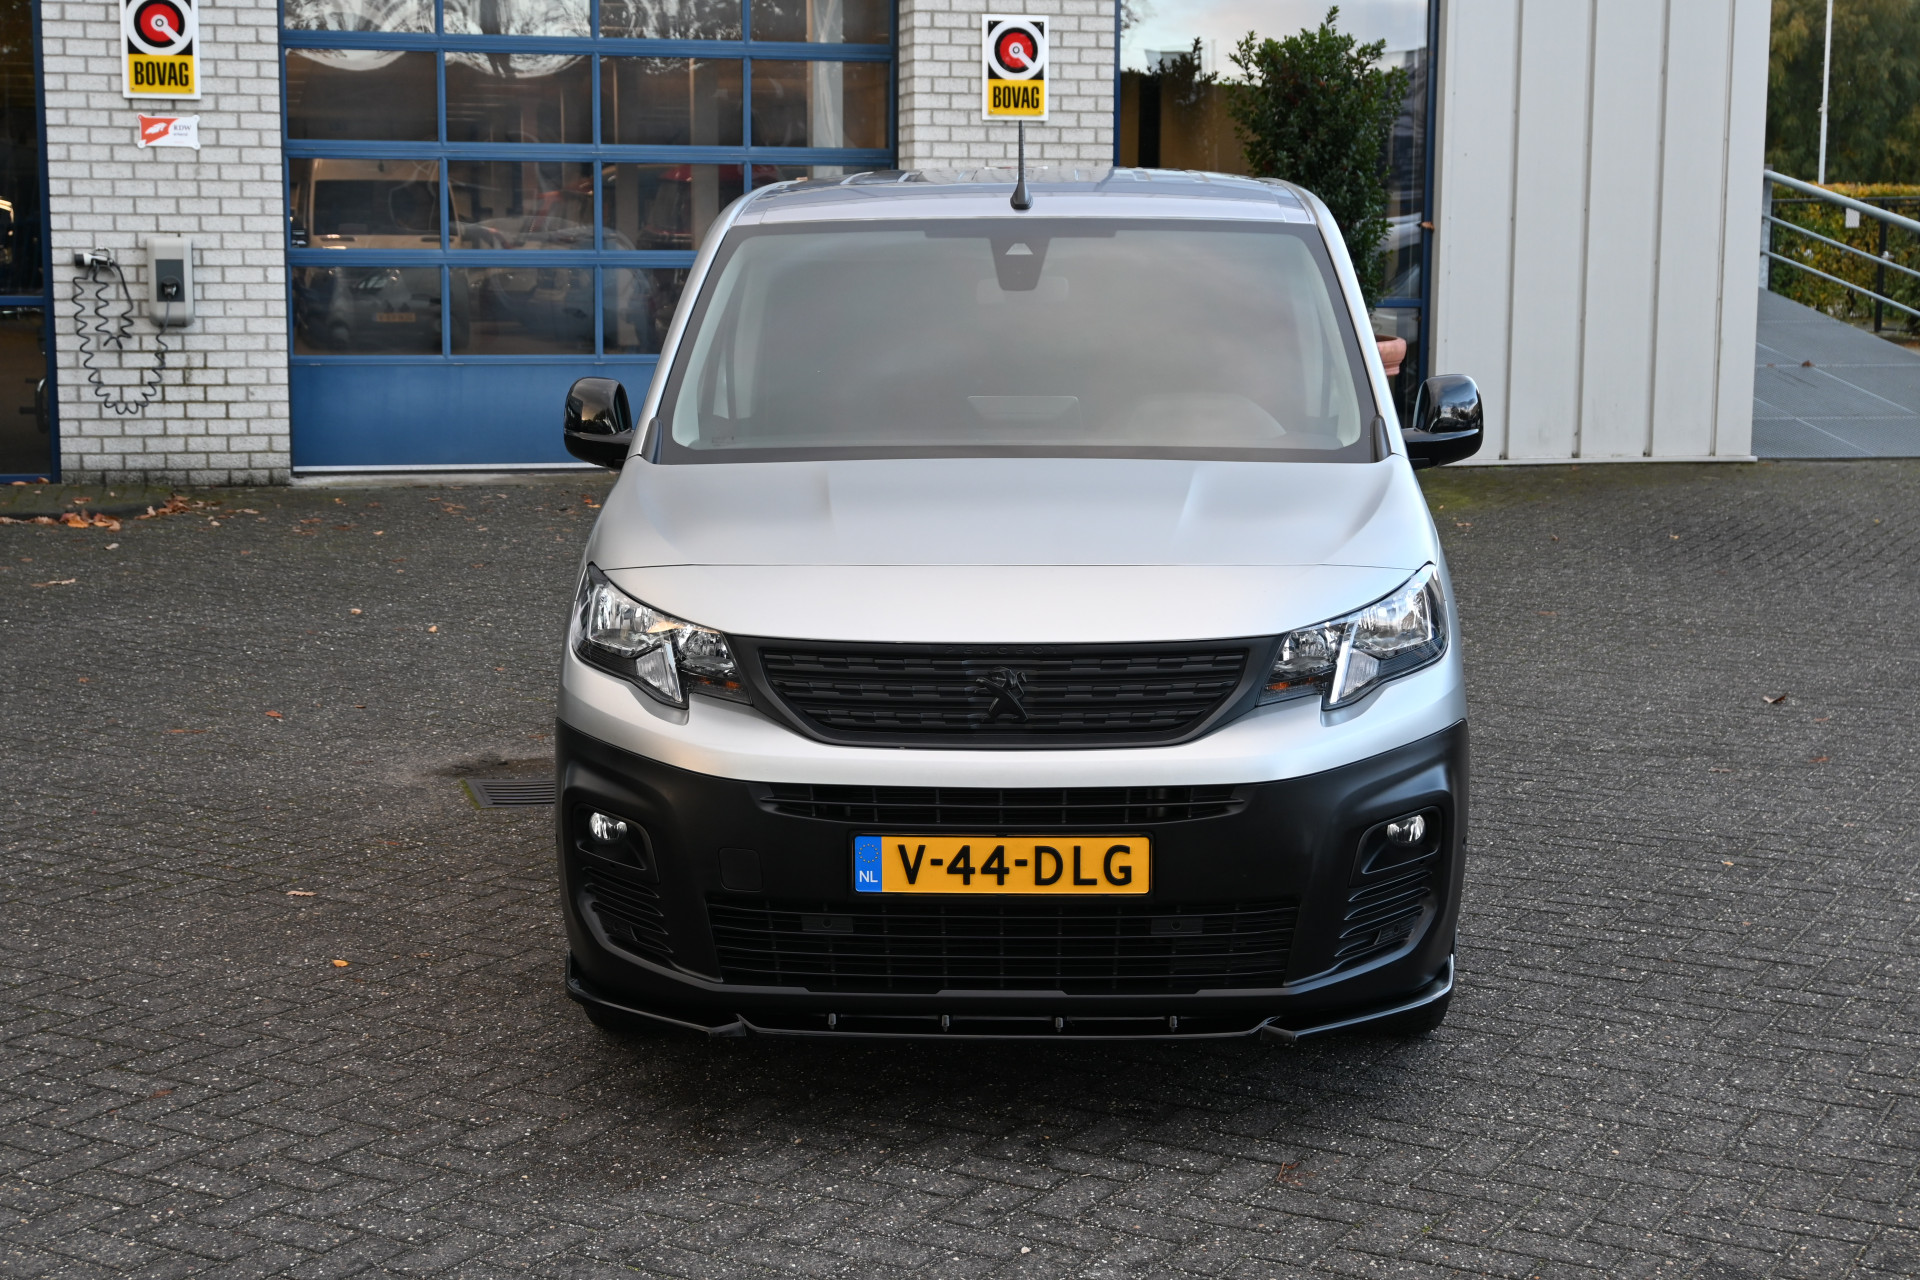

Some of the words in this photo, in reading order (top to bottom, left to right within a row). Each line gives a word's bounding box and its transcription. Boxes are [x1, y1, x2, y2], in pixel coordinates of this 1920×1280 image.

[134, 61, 189, 86] BOVAG
[993, 85, 1040, 109] BOVAG
[859, 870, 878, 883] NL
[897, 844, 1133, 886] V-44-DLG
